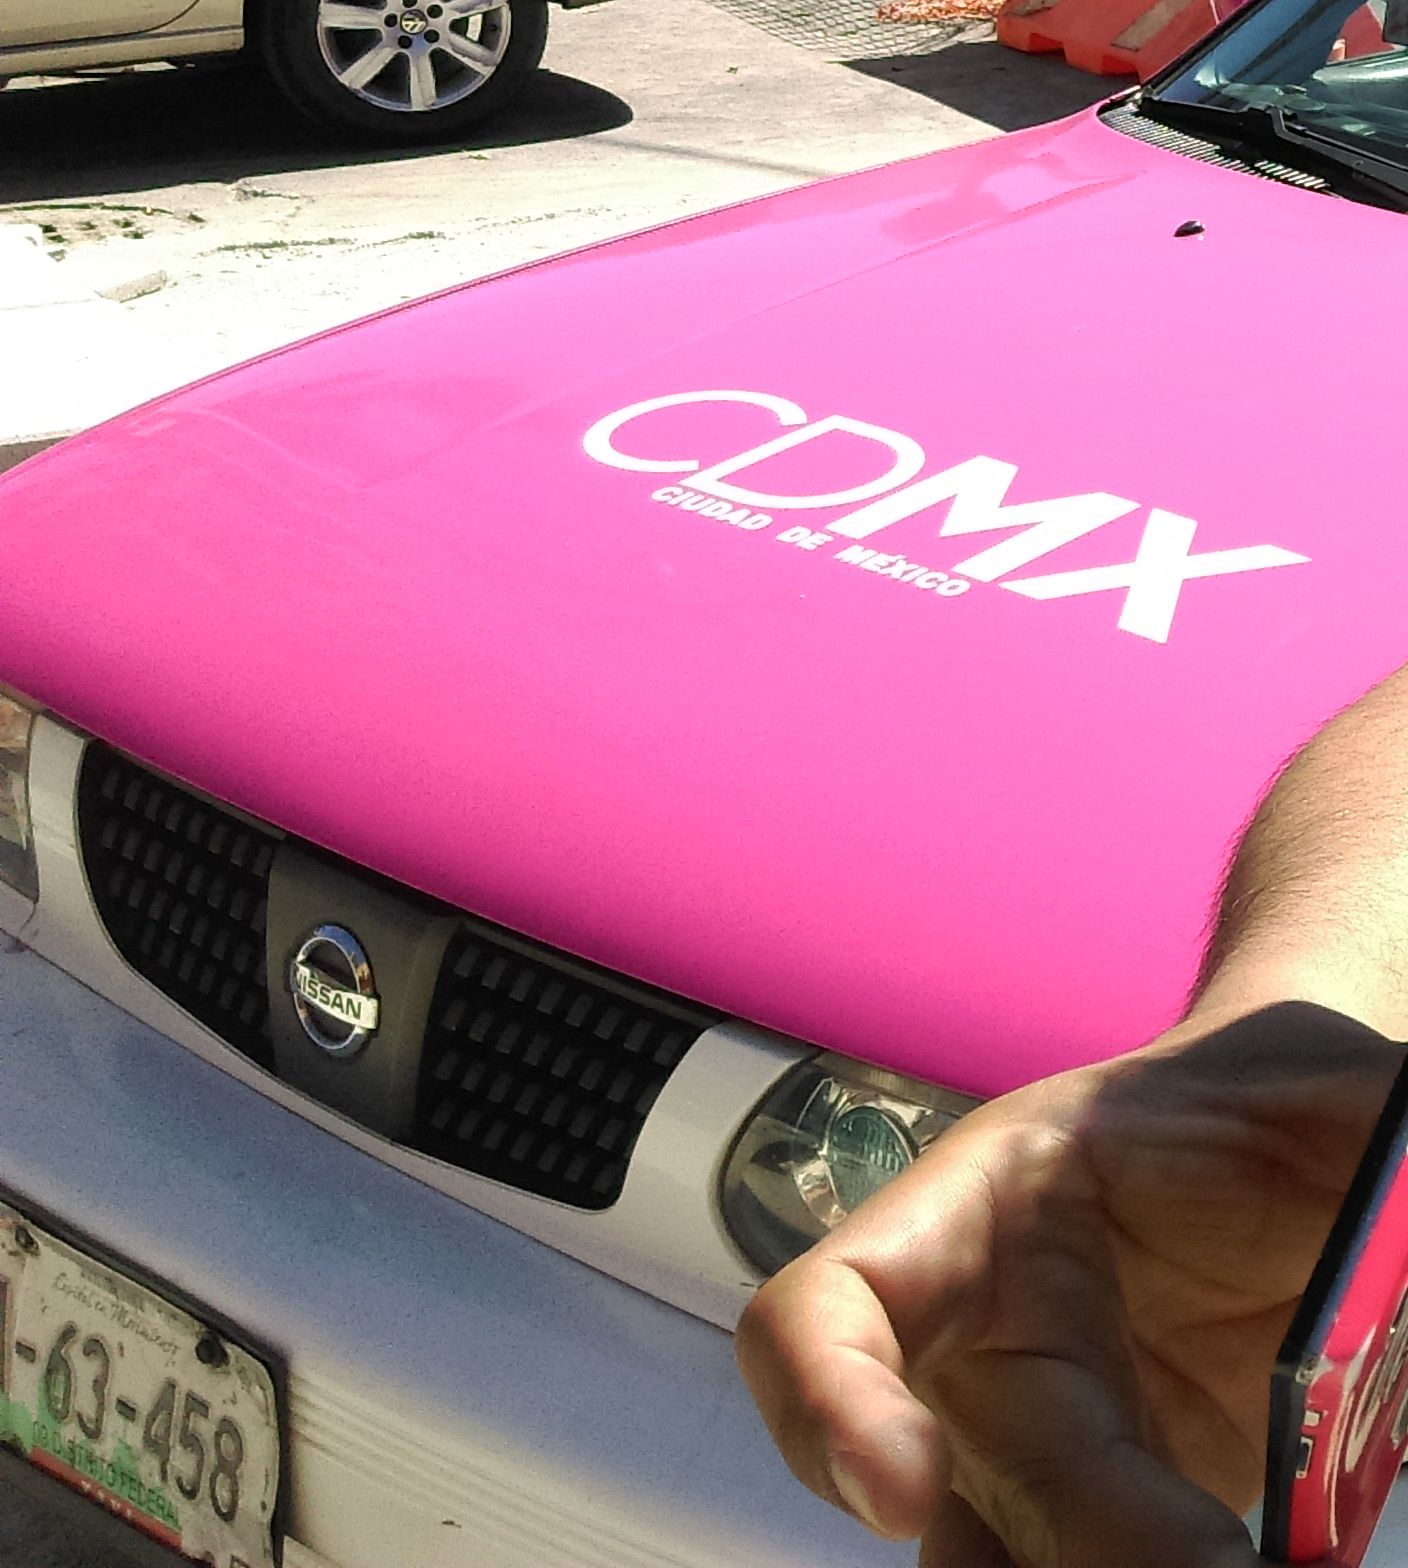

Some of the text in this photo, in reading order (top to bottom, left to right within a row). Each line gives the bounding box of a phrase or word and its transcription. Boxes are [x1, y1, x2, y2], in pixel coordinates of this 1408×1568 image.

[582, 389, 1313, 644] CDMX
[650, 485, 773, 532] CIUDAD
[775, 525, 834, 552] DE
